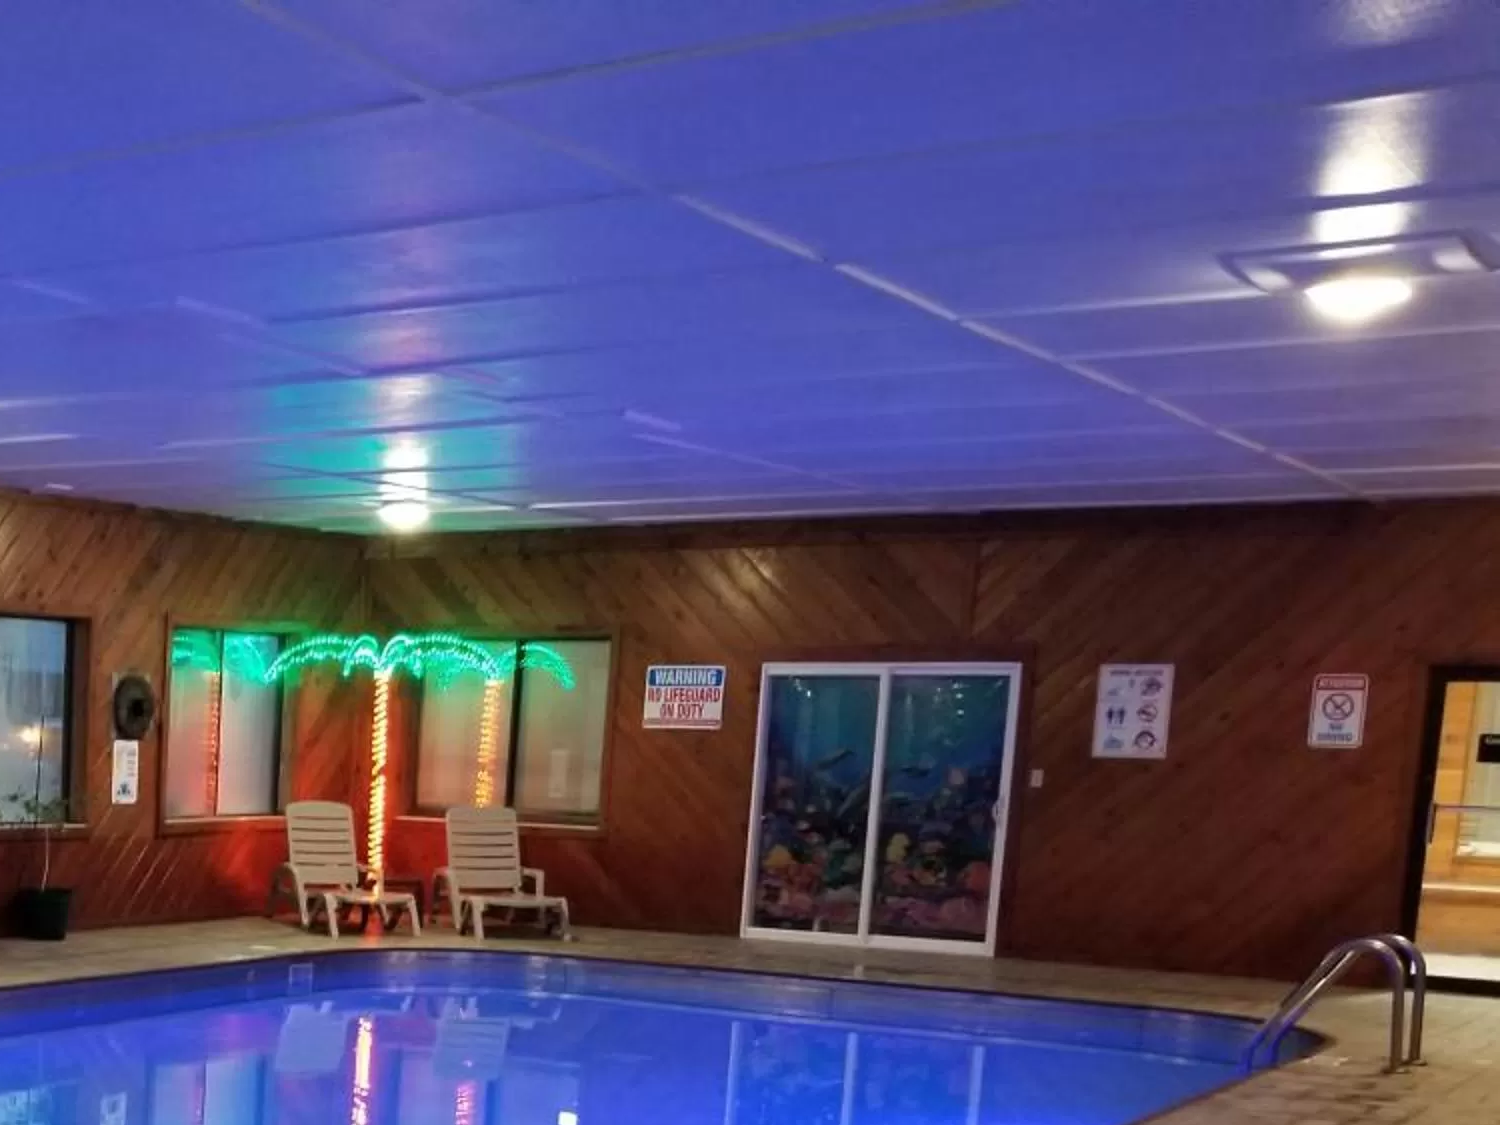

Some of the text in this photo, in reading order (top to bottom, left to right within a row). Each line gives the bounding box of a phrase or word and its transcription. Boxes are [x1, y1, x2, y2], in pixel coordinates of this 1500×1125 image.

[655, 668, 718, 685] WARNING
[647, 687, 721, 703] NO LIFEGUARD
[660, 703, 705, 718] ON DUTY
